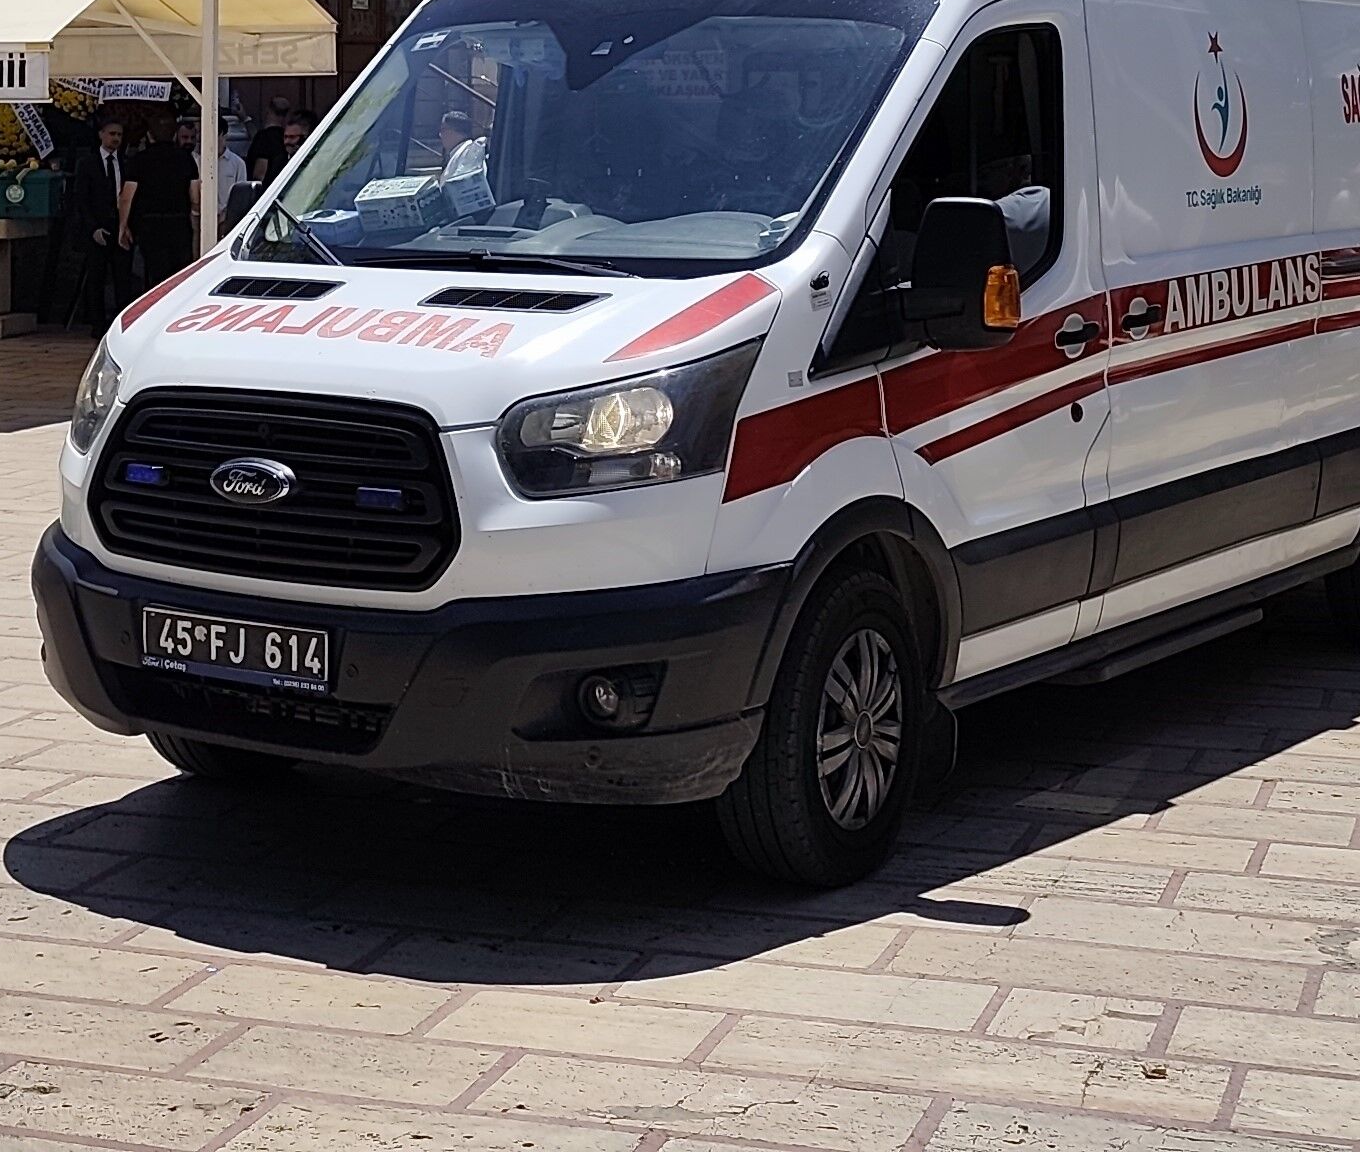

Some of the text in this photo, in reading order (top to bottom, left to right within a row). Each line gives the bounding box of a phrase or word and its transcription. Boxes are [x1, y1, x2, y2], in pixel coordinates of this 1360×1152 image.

[1200, 188, 1225, 209] Sağlık
[1163, 253, 1321, 334] AMBULANS
[223, 468, 267, 497] Ford
[159, 618, 322, 674] 45 FJ 614
